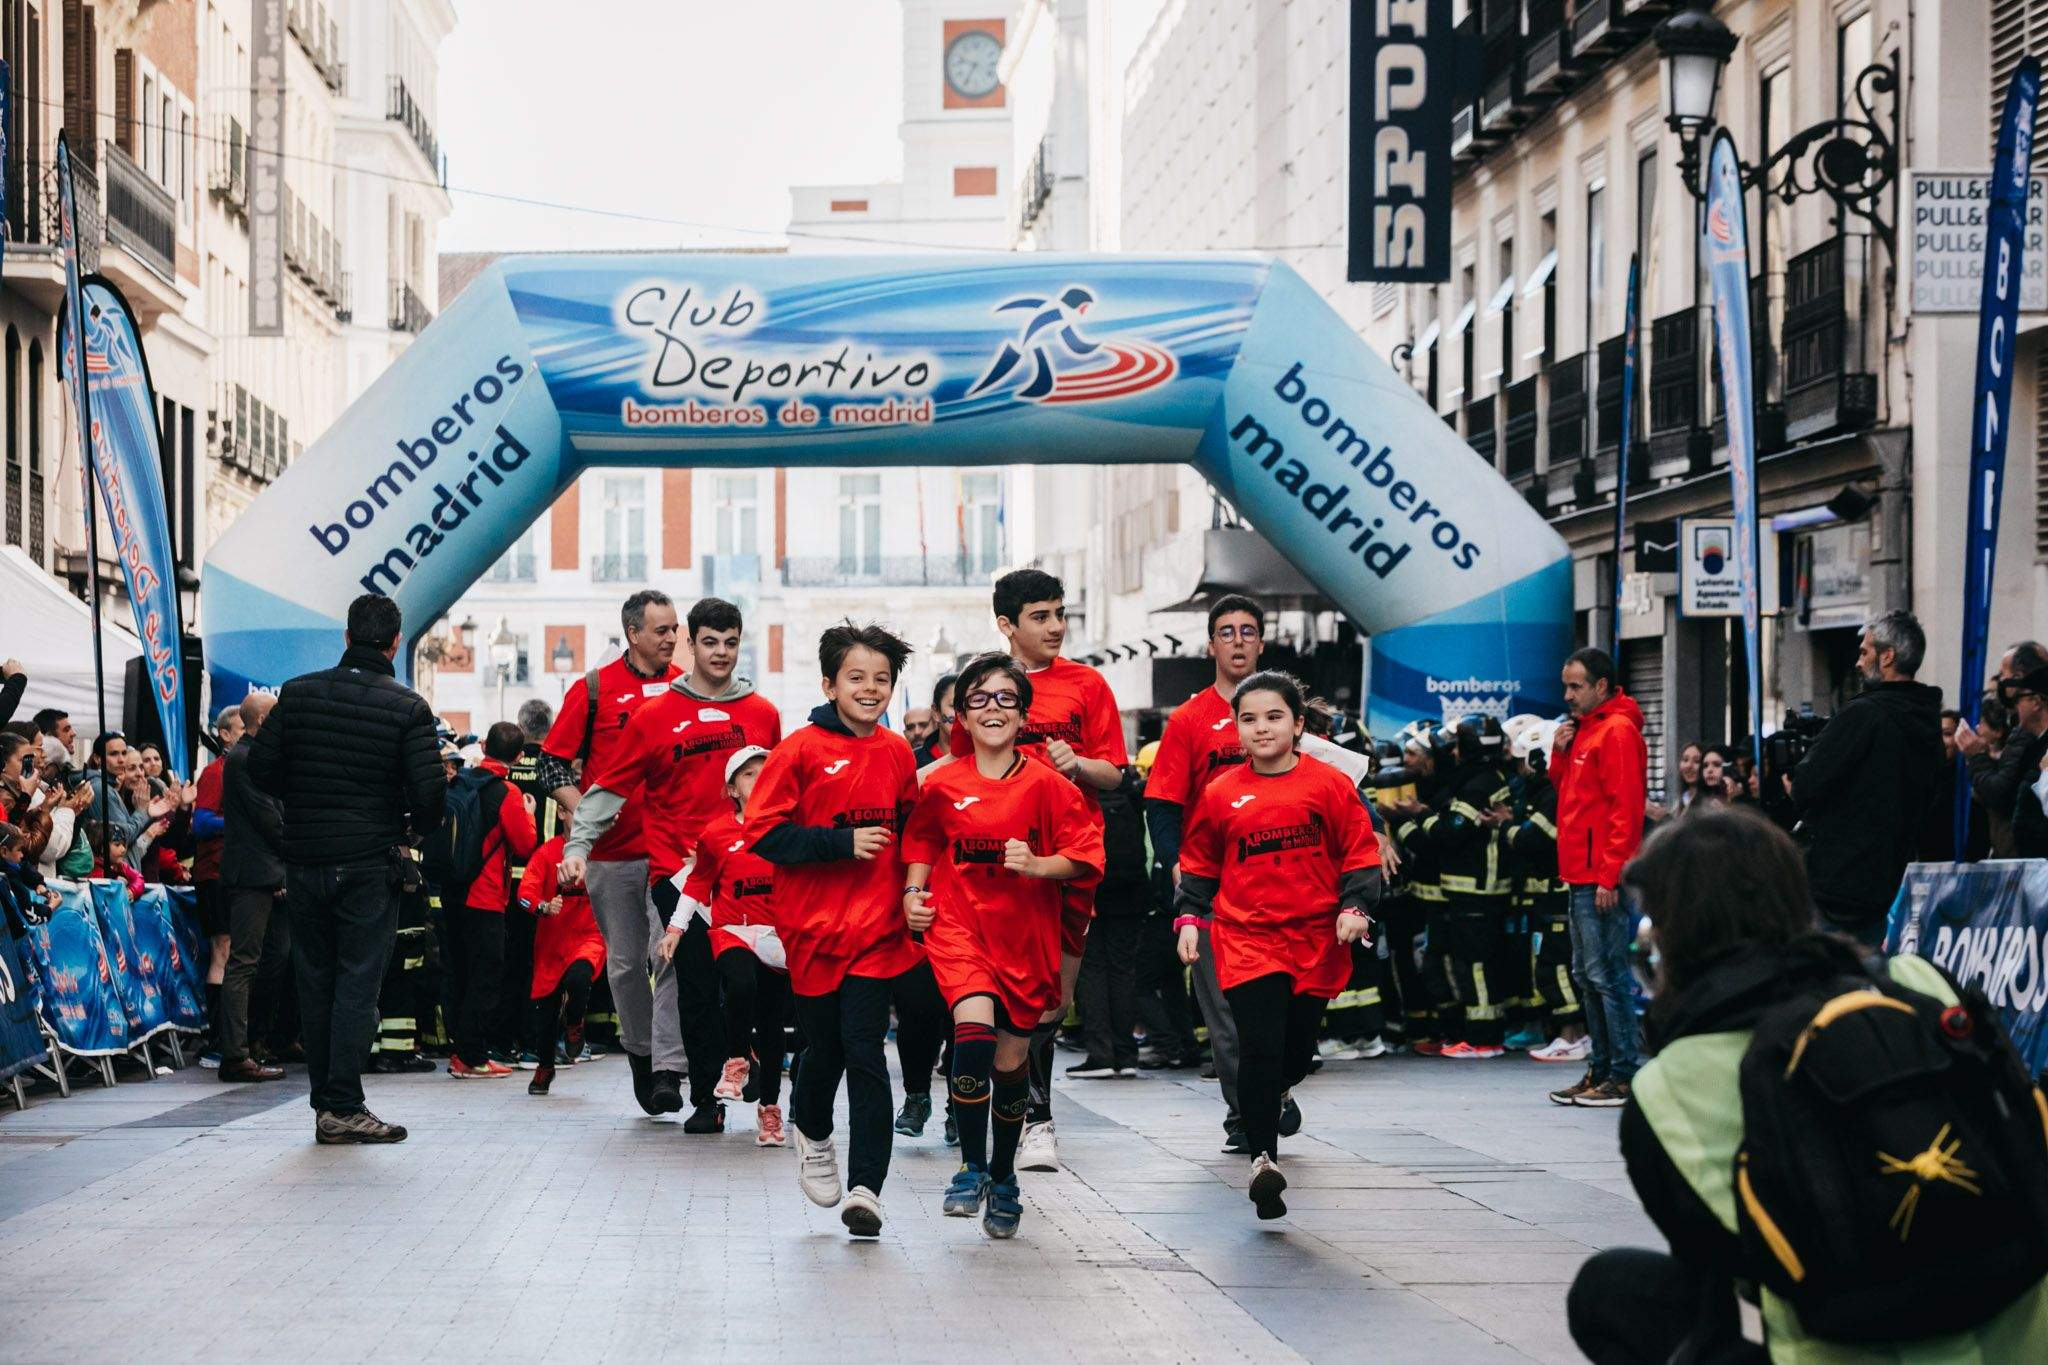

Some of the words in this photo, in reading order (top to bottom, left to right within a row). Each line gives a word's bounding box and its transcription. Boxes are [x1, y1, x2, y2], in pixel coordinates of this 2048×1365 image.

[626, 287, 754, 330] Club
[652, 328, 929, 402] Deportivo
[308, 353, 524, 557] bomberos
[626, 401, 764, 425] bomberos
[781, 401, 817, 425] de
[834, 401, 931, 424] madrid
[1273, 361, 1481, 570] bomberos
[359, 423, 532, 597] madrid
[1229, 413, 1412, 580] madrid
[1425, 675, 1522, 693] bomberos
